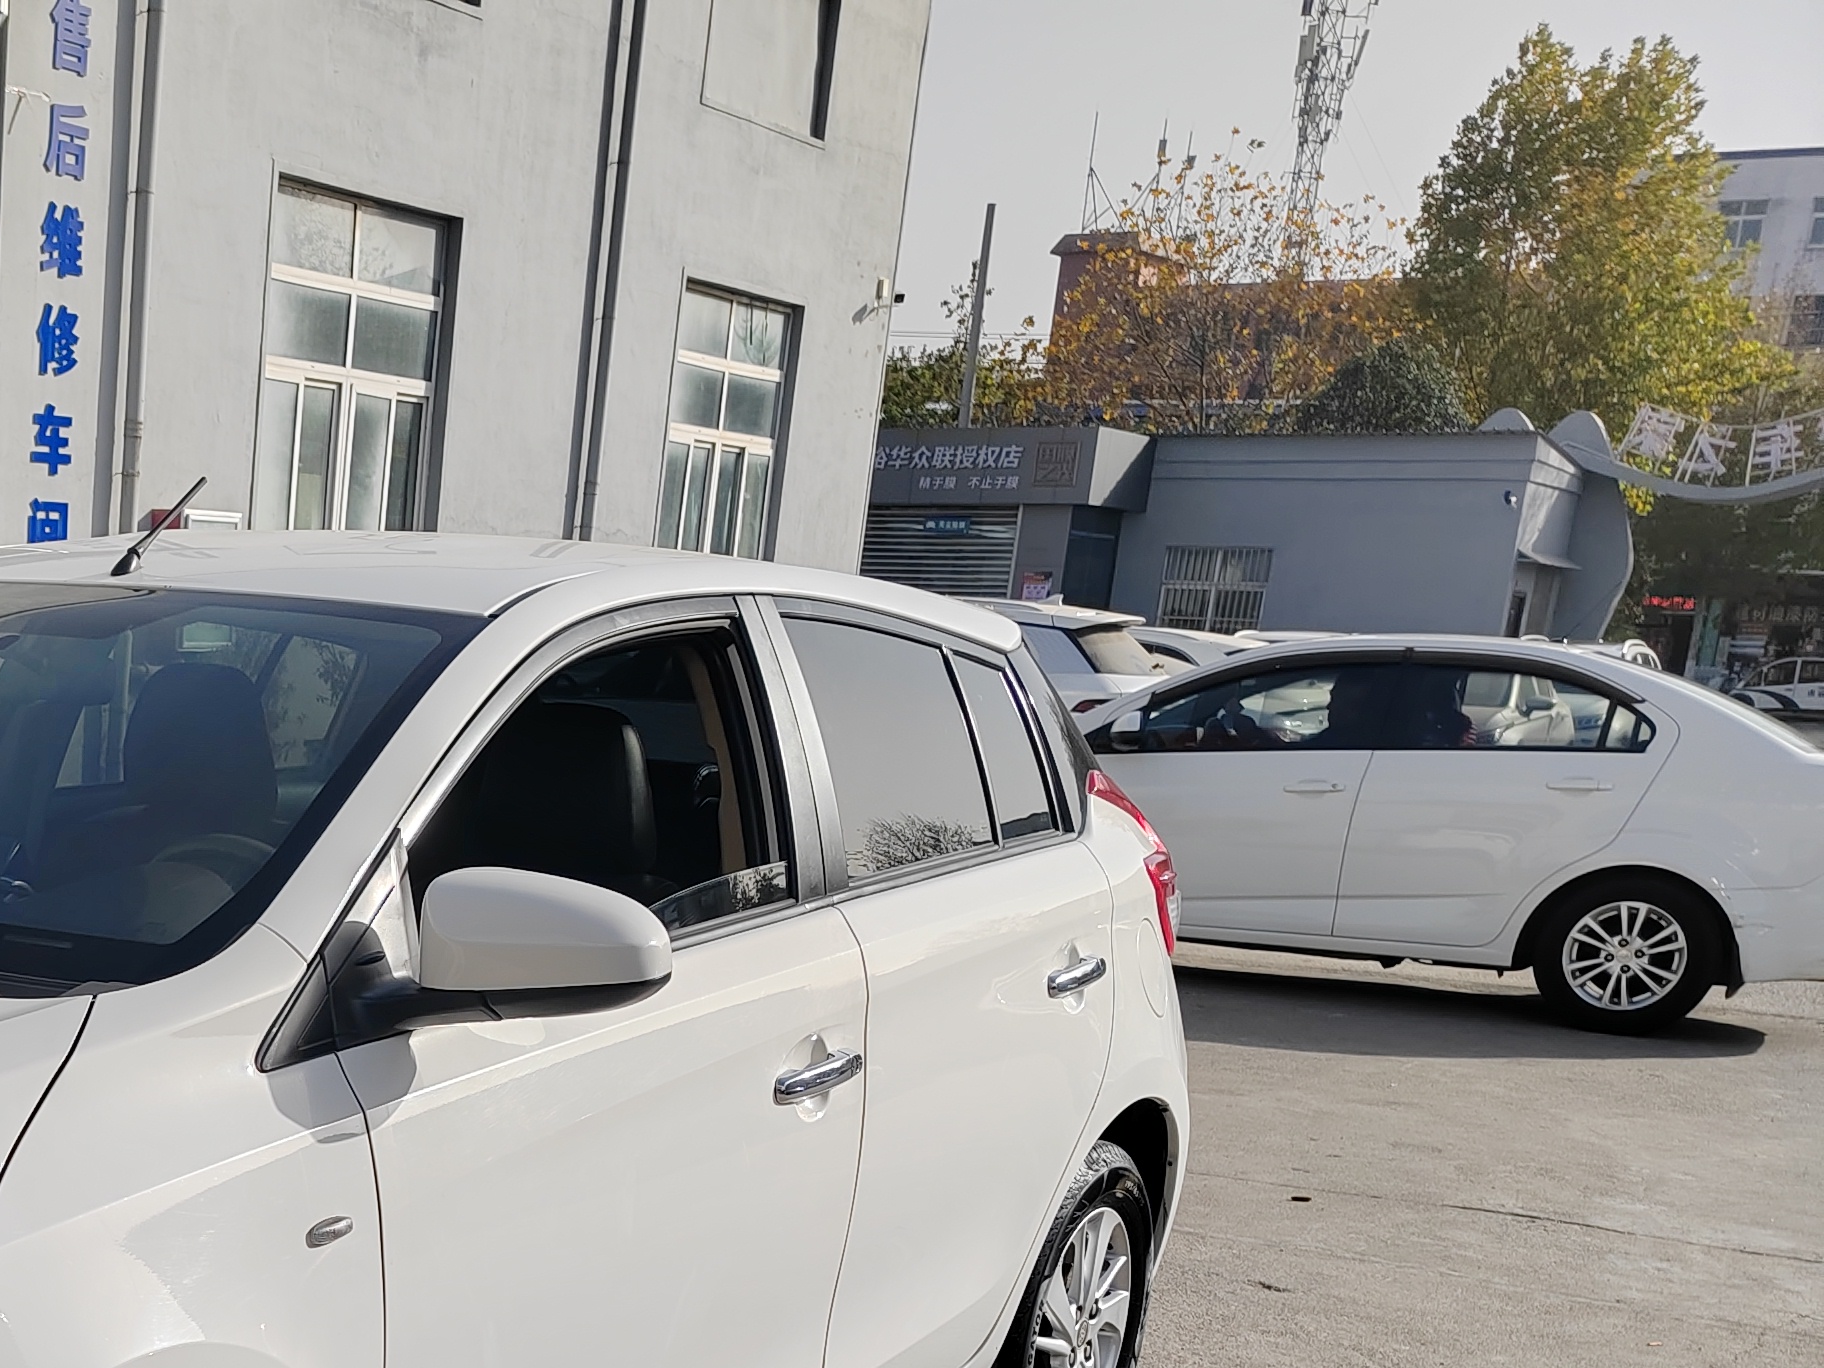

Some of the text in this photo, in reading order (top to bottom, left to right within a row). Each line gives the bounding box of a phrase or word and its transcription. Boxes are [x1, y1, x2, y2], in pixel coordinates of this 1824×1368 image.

[28, 0, 92, 544] 售后维修车间
